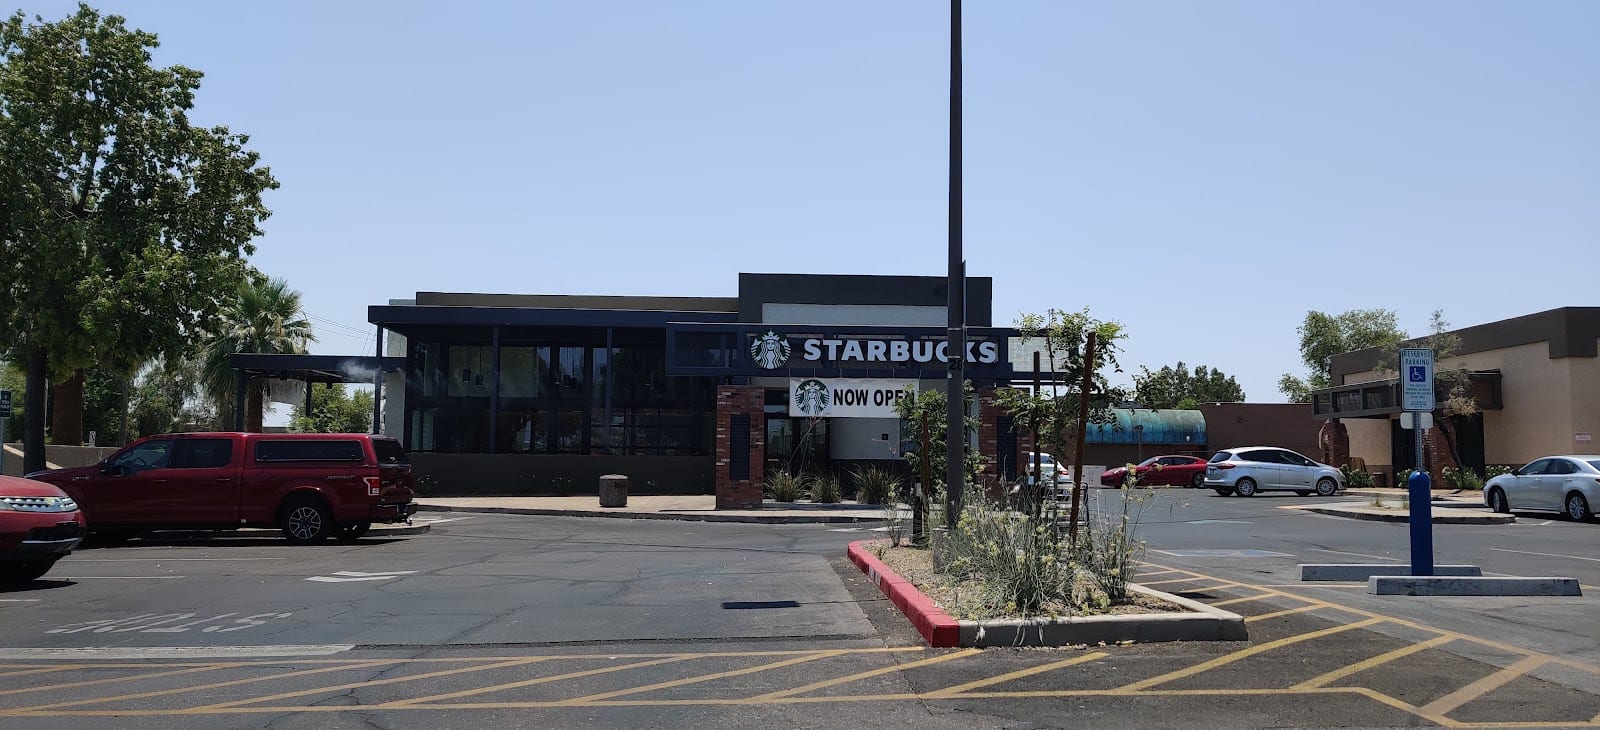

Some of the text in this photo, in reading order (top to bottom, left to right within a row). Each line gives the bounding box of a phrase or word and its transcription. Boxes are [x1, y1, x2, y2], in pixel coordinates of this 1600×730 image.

[803, 339, 997, 364] STARBUCKS
[1404, 350, 1431, 358] RESERVED
[833, 389, 869, 406] NOW
